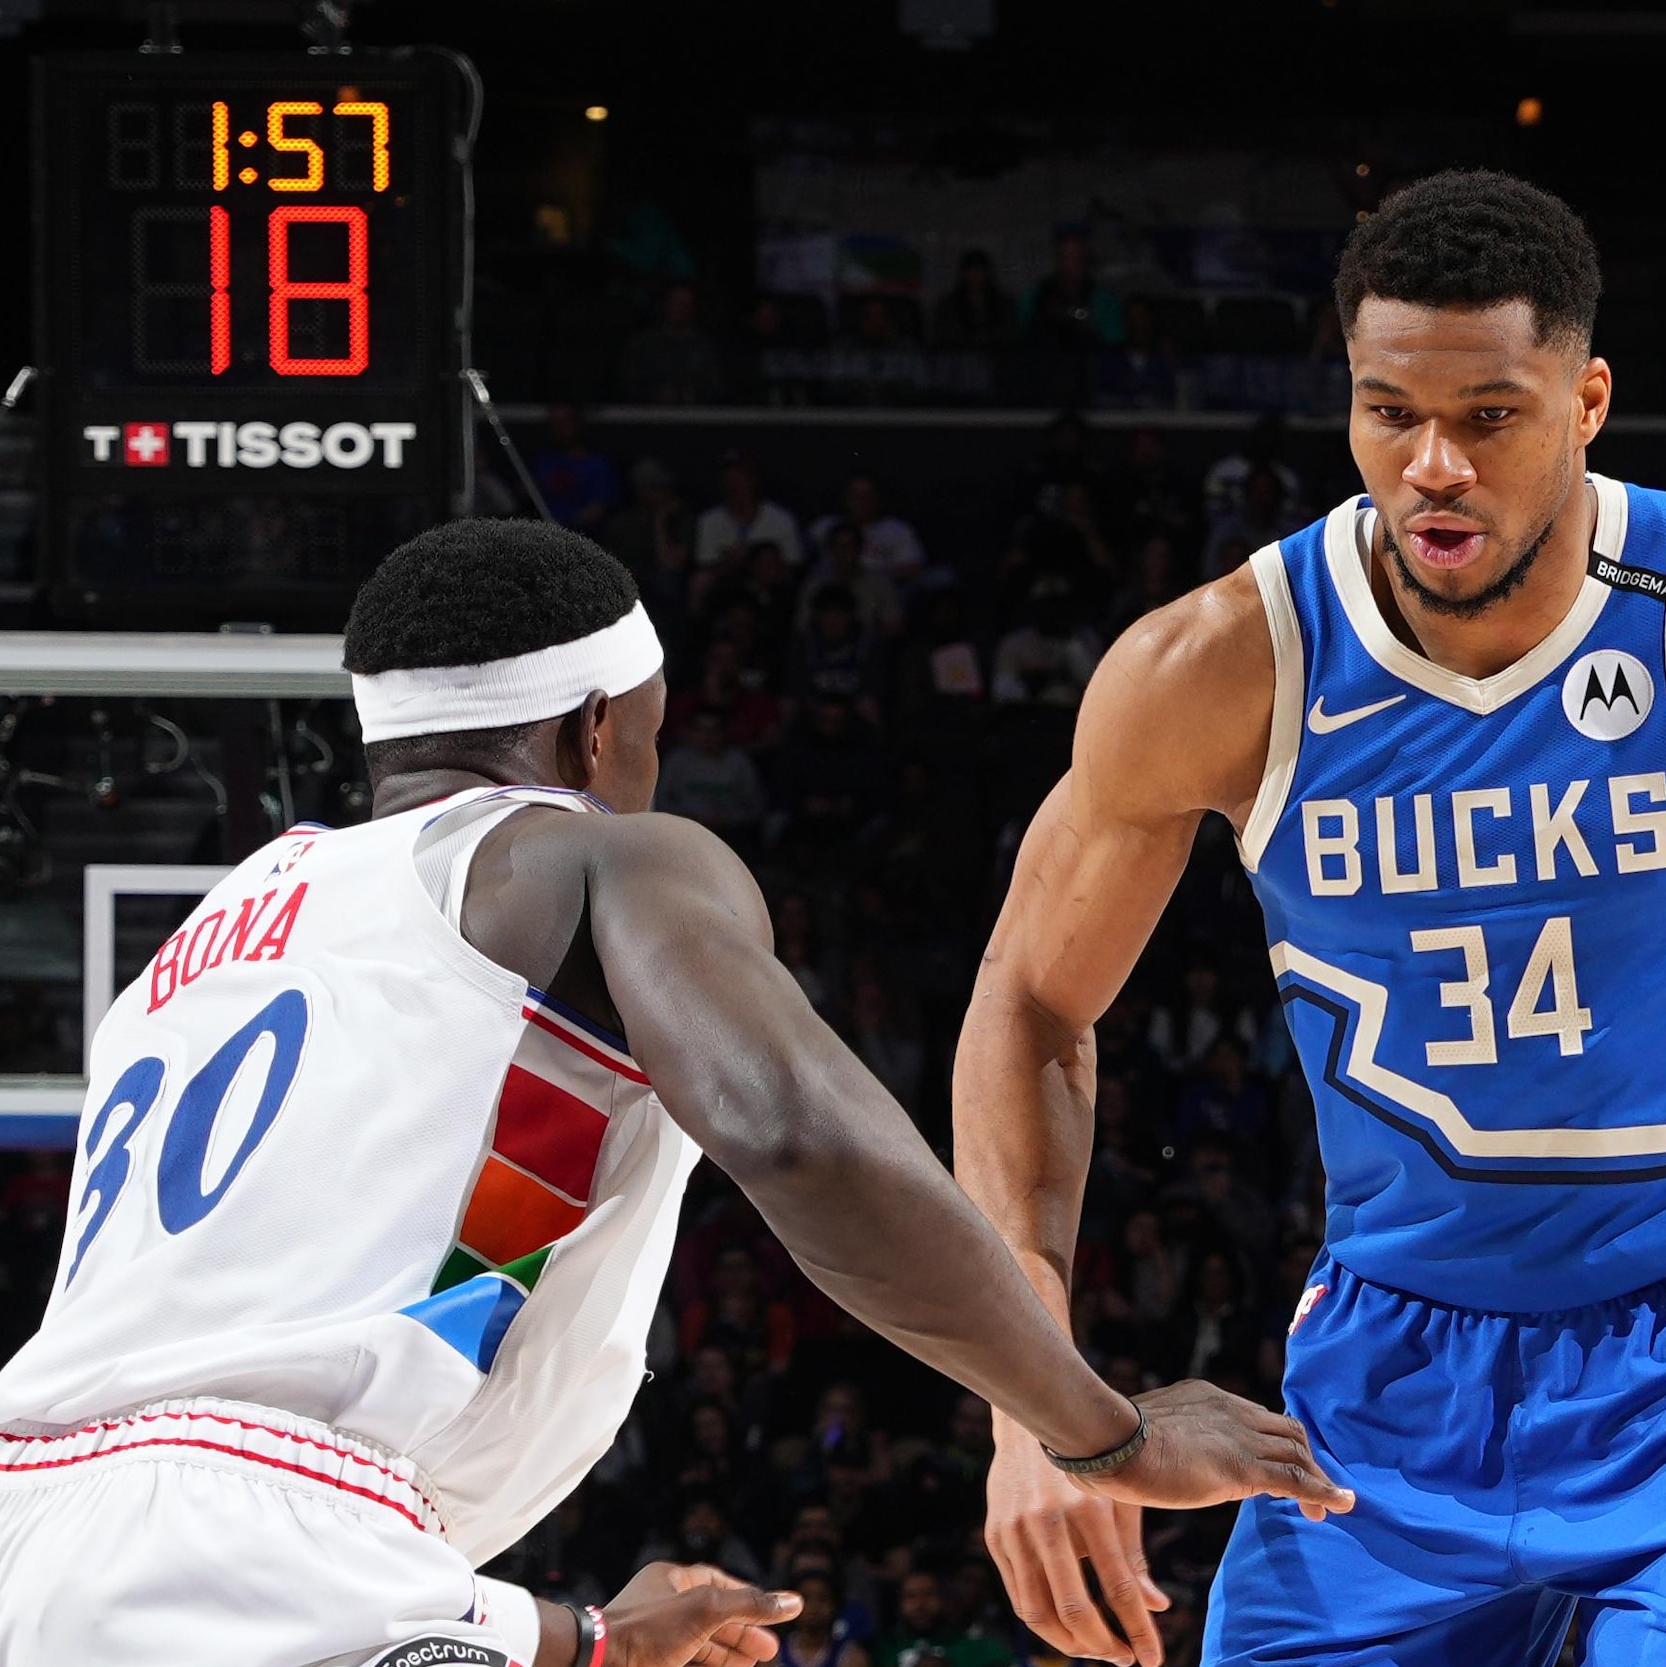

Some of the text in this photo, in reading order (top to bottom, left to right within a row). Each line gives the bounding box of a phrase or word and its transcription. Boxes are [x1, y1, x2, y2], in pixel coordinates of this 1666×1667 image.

[212, 101, 389, 192] 1:57
[210, 205, 369, 376] 18
[174, 421, 416, 468] TISSOT
[146, 882, 309, 1015] BONA
[1409, 916, 1593, 1067] 34
[66, 989, 309, 1292] 30
